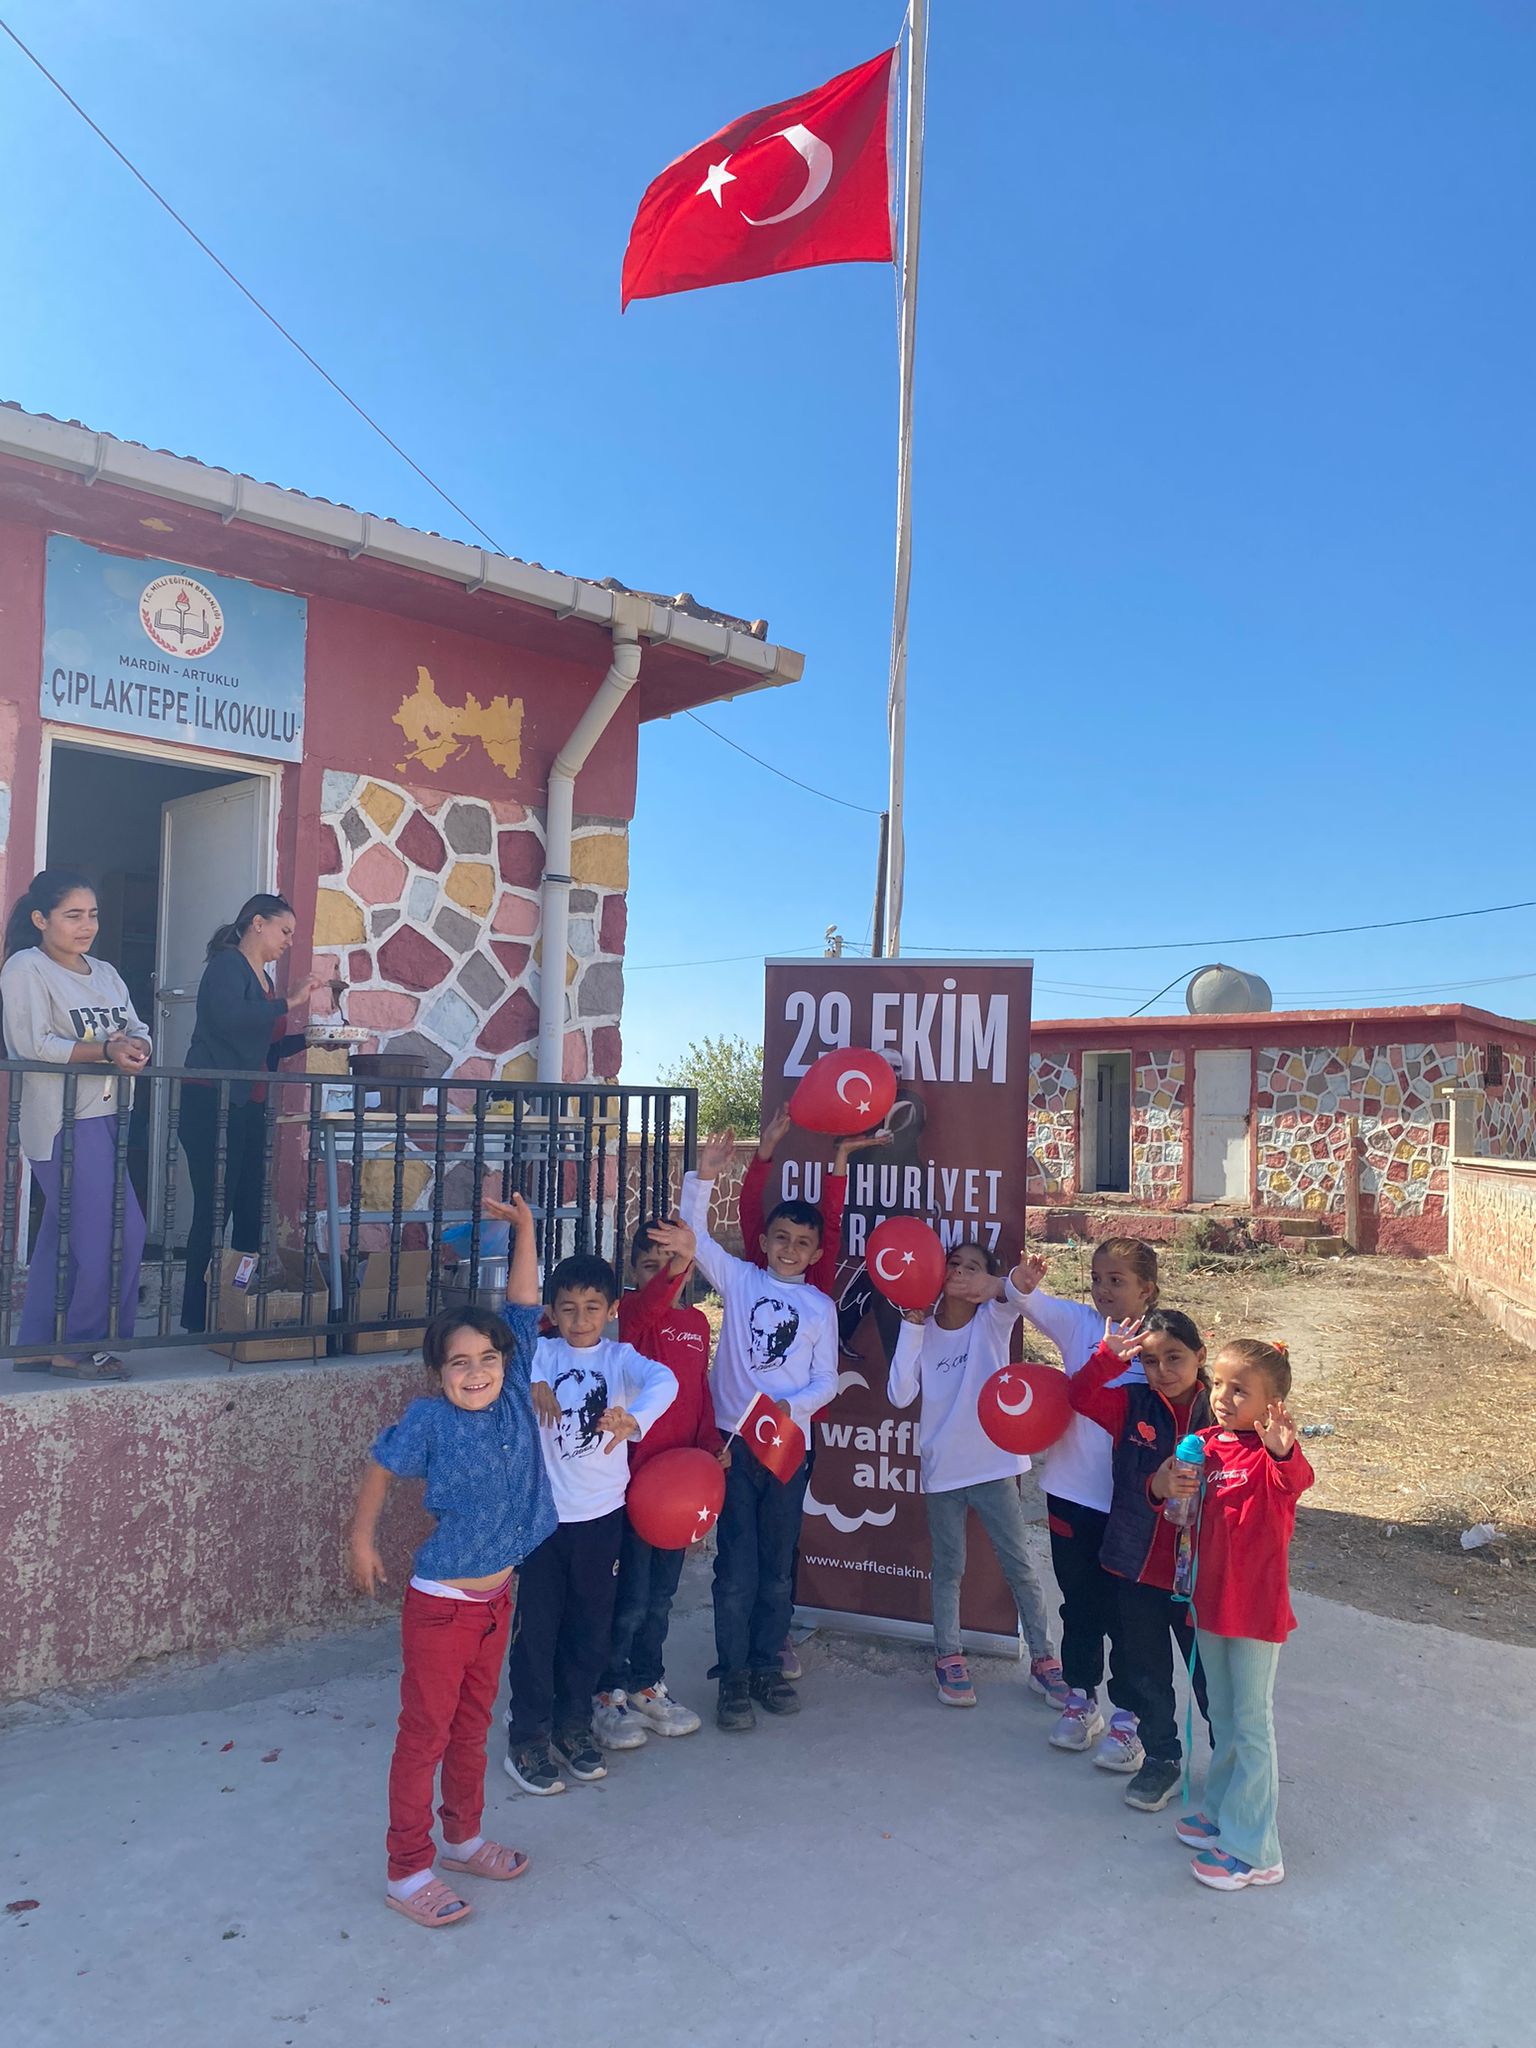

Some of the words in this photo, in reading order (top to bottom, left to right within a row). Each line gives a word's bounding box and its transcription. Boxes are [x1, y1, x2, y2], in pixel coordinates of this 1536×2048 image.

[119, 654, 170, 674] MARDİN
[182, 668, 239, 688] ARTUKLU
[52, 668, 188, 725] ÇIPLAKTEPE
[194, 686, 295, 743] İLKOKULU
[783, 991, 851, 1077] 29
[871, 978, 1008, 1083] EKİM
[782, 1160, 1002, 1214] CUHURİYET
[853, 1456, 926, 1494] akı
